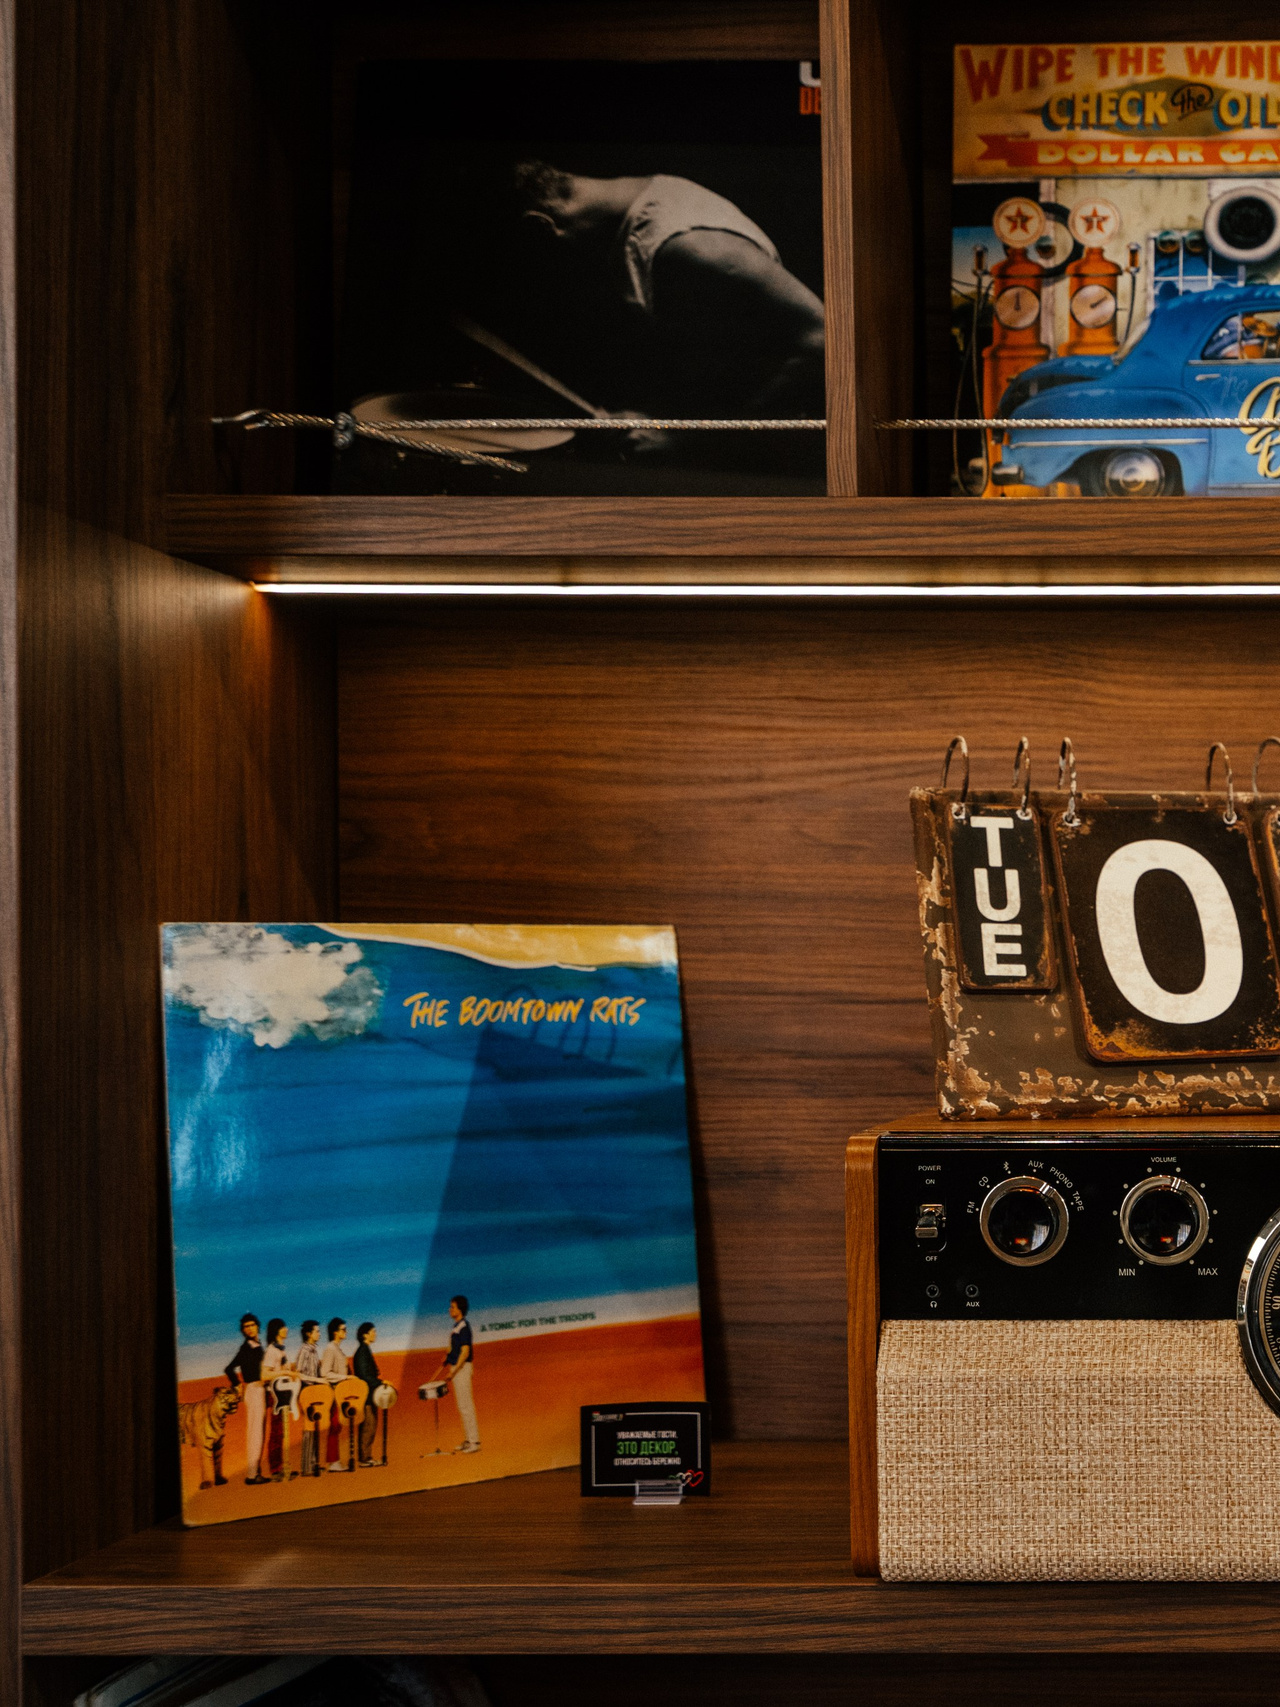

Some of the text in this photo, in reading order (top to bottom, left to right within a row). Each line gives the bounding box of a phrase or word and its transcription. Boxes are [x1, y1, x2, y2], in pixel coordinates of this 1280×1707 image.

[958, 47, 1075, 101] WIPE
[1094, 46, 1167, 79] THE
[1045, 90, 1168, 130] CHECK
[1170, 82, 1214, 121] the
[1037, 143, 1204, 165] DOLLAR
[970, 816, 1027, 977] TUE
[403, 992, 647, 1028] THE BOOMTOWN RATS
[1028, 1160, 1044, 1169] AUX
[978, 1176, 989, 1187] CD
[1050, 1166, 1074, 1189] PHONO
[967, 1201, 976, 1214] FM
[1072, 1190, 1085, 1212] TAPE
[1118, 1268, 1136, 1276] MIN
[1197, 1267, 1218, 1276] MAX
[488, 1320, 516, 1331] TONIC
[518, 1318, 537, 1328] FOR
[538, 1316, 557, 1325] THE
[558, 1311, 597, 1323] TROOPS
[617, 1441, 638, 1455] ЭТО
